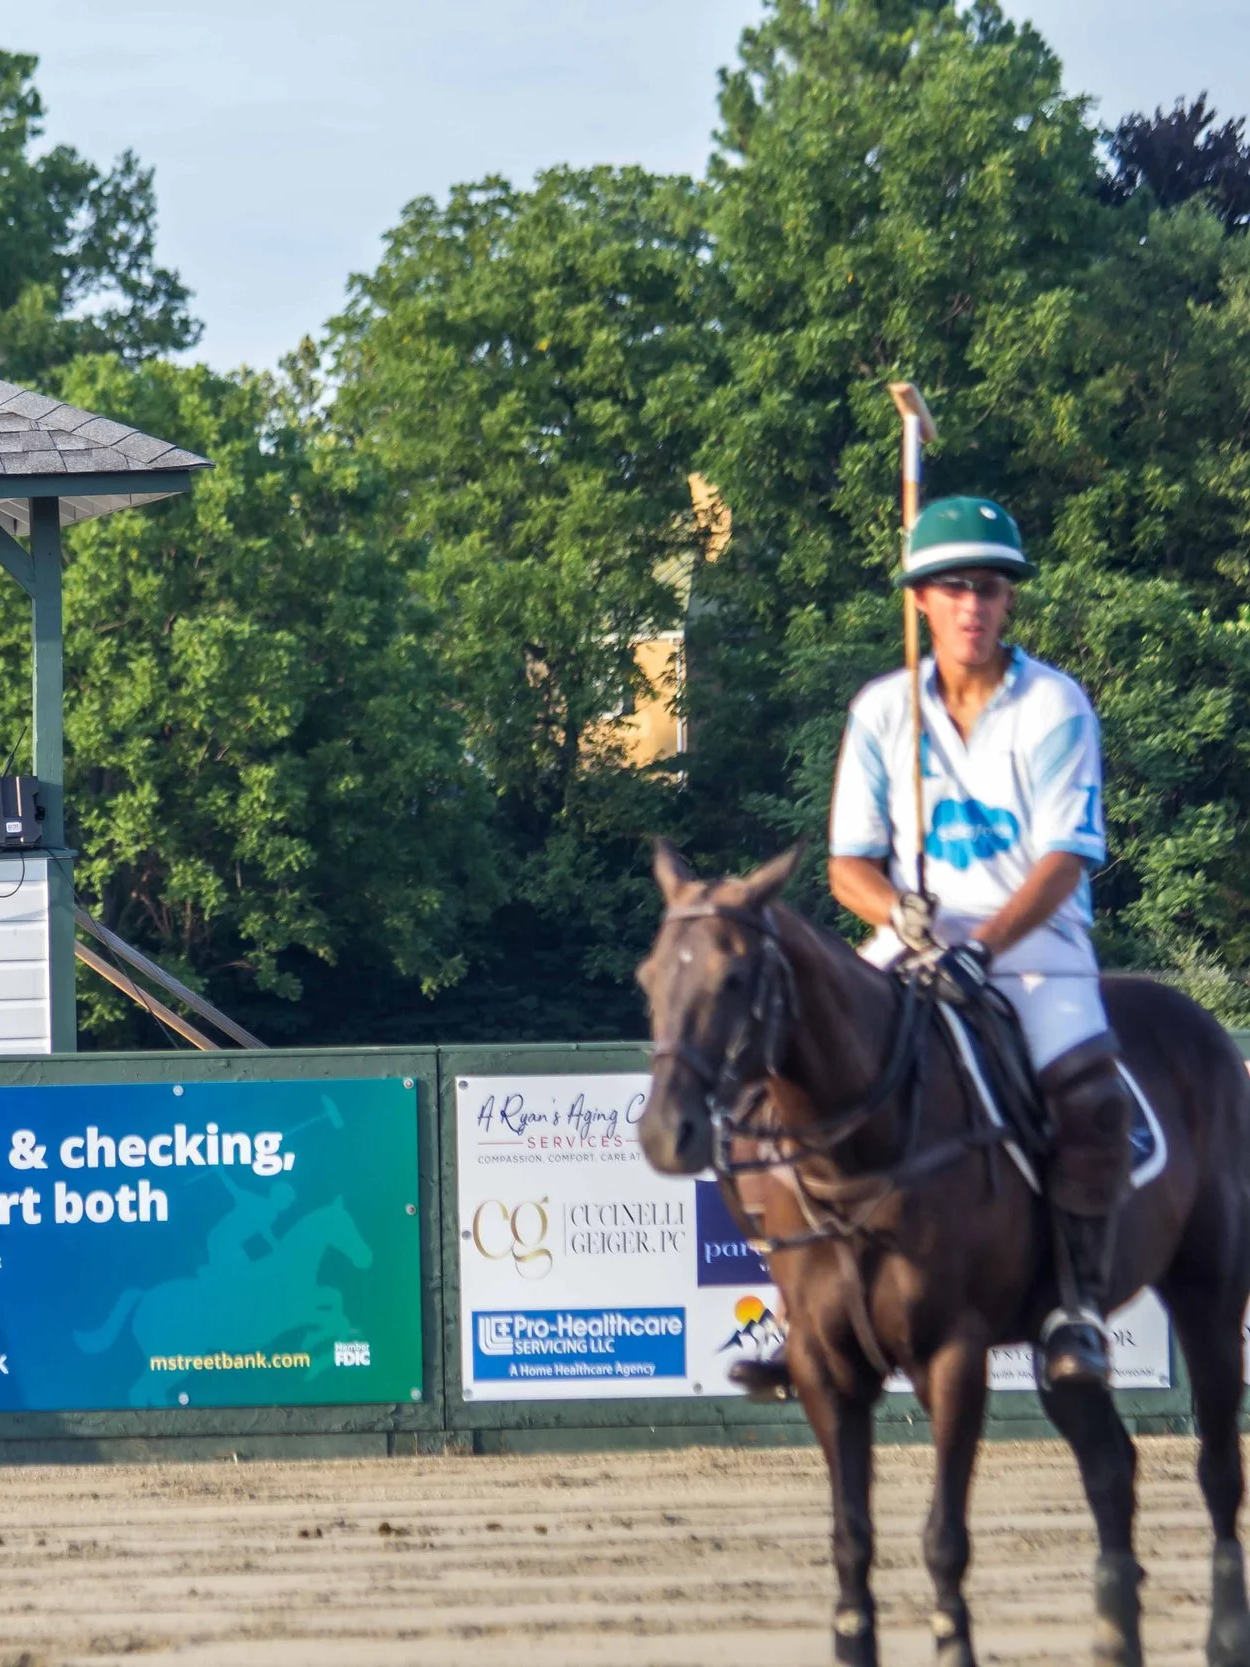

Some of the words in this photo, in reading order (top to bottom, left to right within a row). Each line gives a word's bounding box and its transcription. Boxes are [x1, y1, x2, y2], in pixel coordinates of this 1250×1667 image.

[1074, 785, 1104, 835] 1
[477, 1095, 495, 1132] A
[500, 1094, 561, 1136] Ryan's
[567, 1093, 619, 1139] Aging
[9, 1129, 49, 1170] &
[60, 1123, 296, 1176] checking,
[527, 1135, 623, 1149] SERVICES
[600, 1153, 627, 1162] CARE
[630, 1153, 641, 1162] AT
[54, 1180, 169, 1225] both
[571, 1202, 685, 1227] CUCINELLI
[660, 1230, 686, 1253] PC
[514, 1312, 683, 1338] Pro-Healthcare
[334, 1341, 370, 1351] Member
[515, 1339, 587, 1355] SERVICING
[589, 1338, 616, 1354] LLC
[150, 1351, 310, 1372] mstreetbank.com
[335, 1351, 371, 1367] FDIC
[510, 1364, 518, 1377] A
[520, 1363, 553, 1376] Home
[554, 1361, 613, 1376] Healthcare
[615, 1361, 656, 1377] Agency
